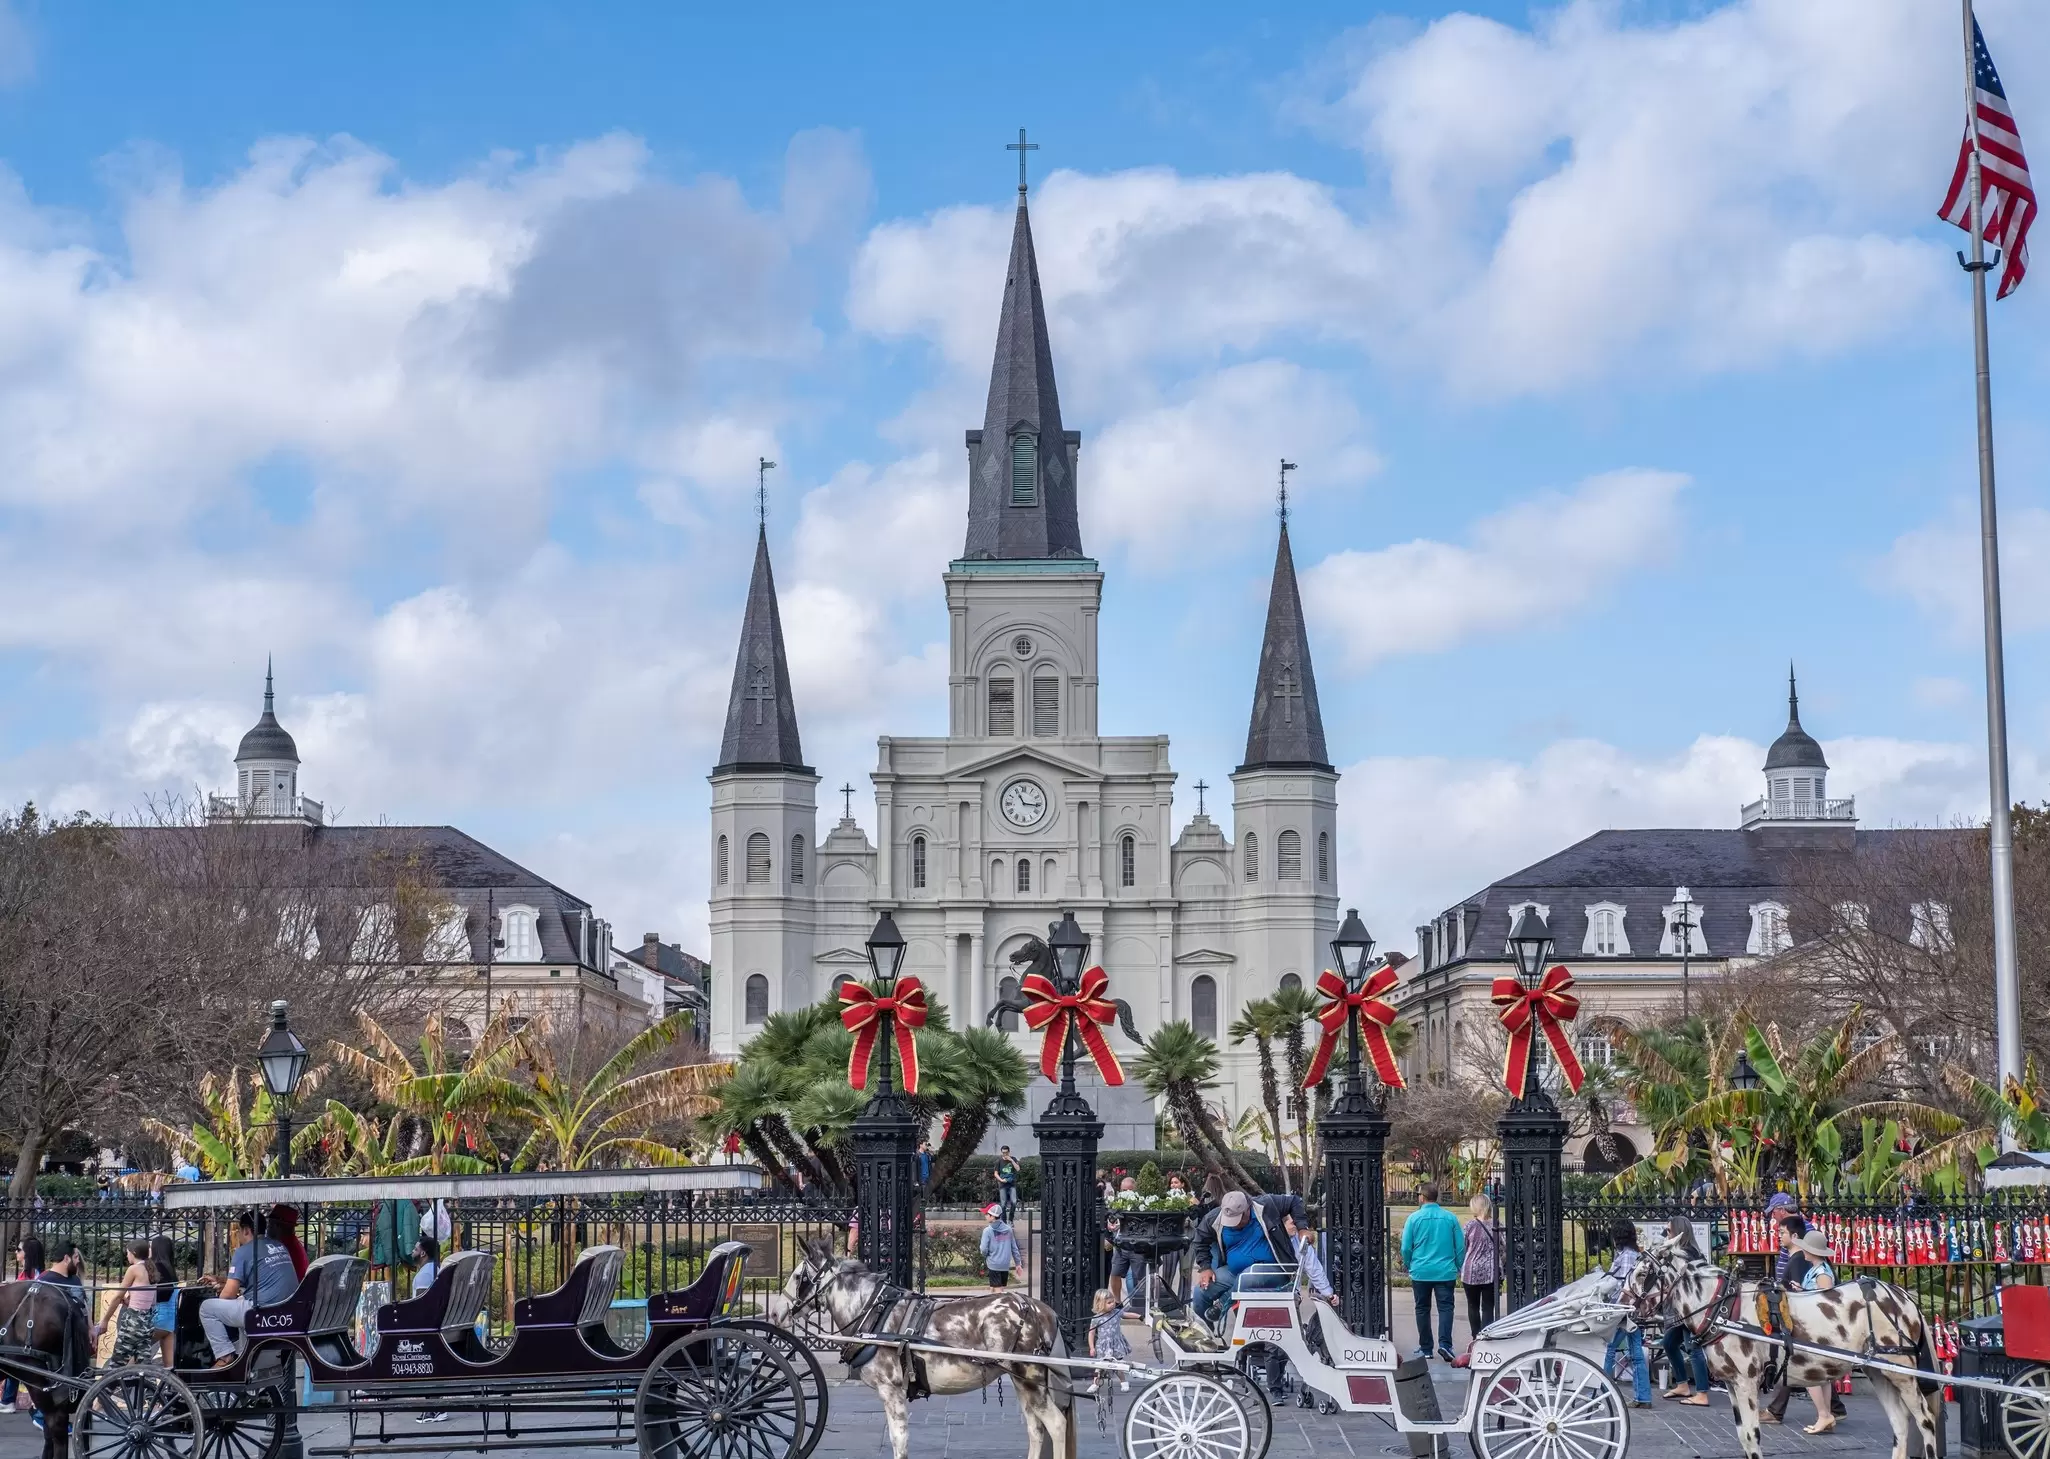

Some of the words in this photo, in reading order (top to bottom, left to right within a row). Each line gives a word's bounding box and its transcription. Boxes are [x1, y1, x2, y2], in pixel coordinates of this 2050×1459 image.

[260, 1314, 293, 1328] AC-05
[1248, 1328, 1266, 1340] AC
[1268, 1329, 1283, 1341] 23
[1343, 1349, 1387, 1363] ROLLIN
